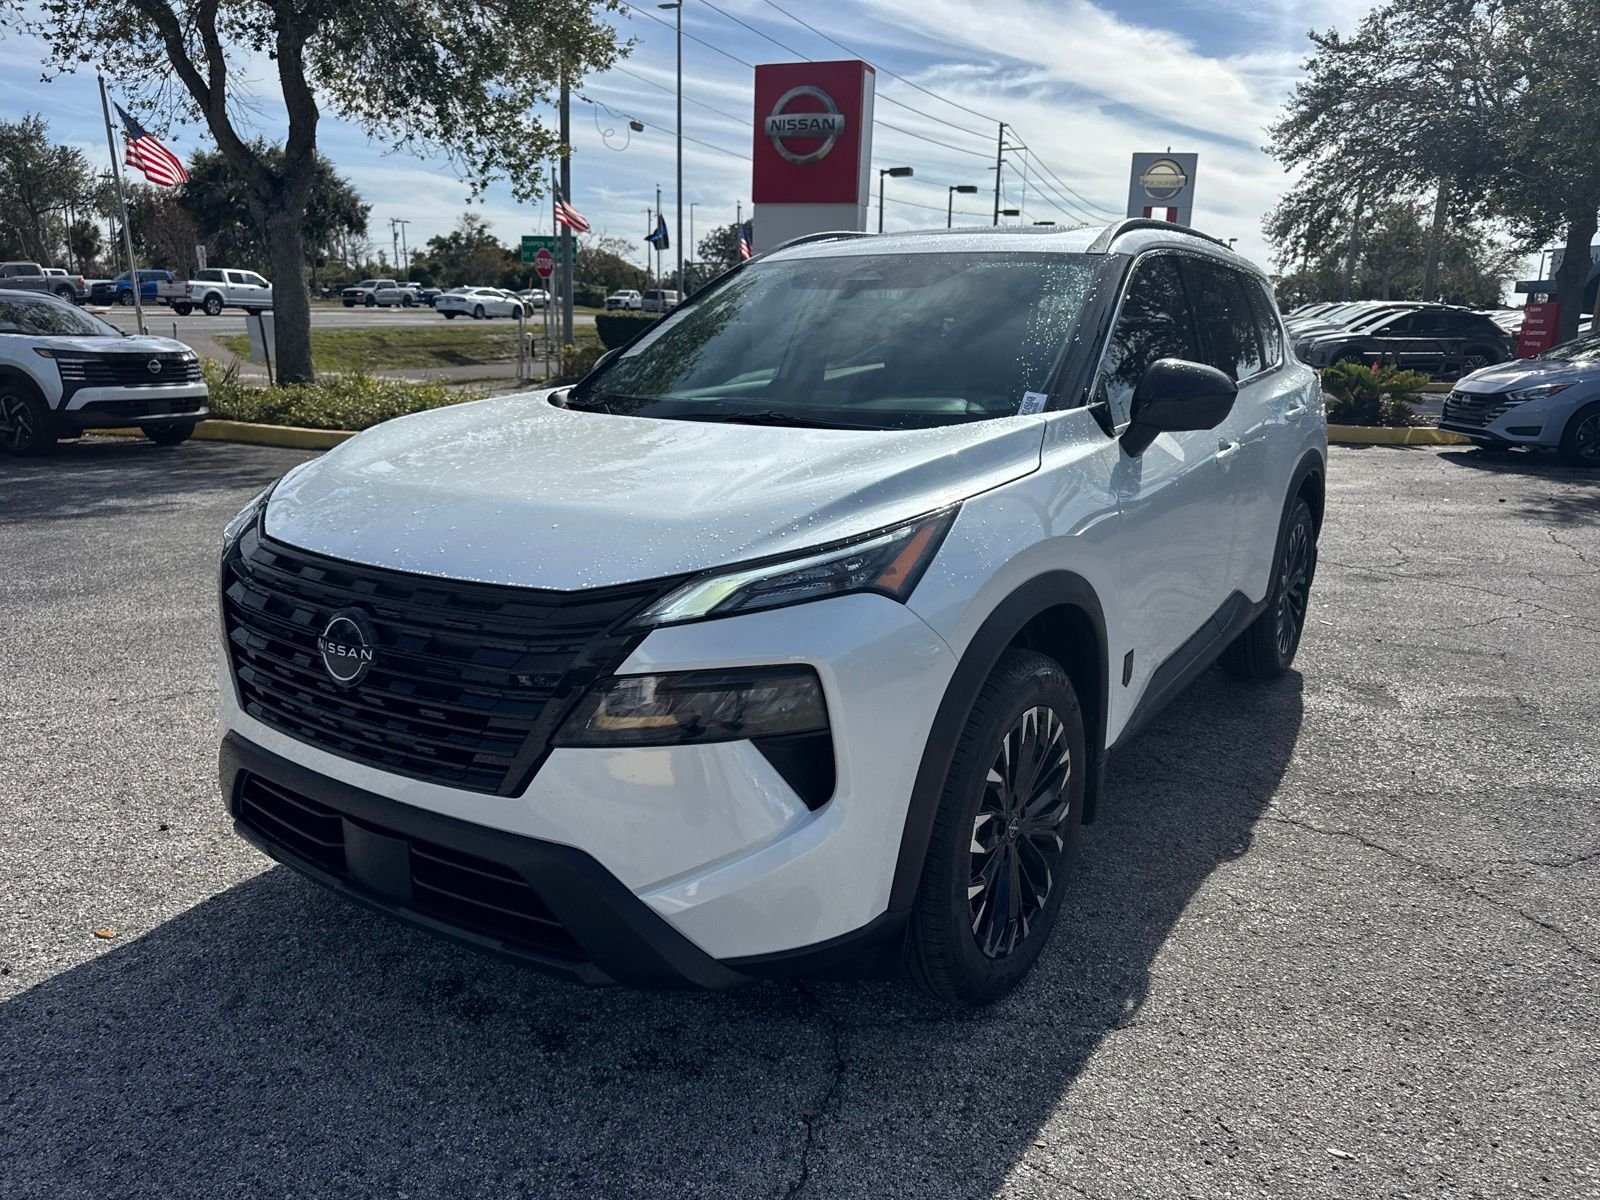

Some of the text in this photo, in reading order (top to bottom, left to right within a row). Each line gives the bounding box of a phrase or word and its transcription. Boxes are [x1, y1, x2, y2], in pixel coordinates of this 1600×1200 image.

[770, 118, 836, 132] NISSAN
[537, 257, 552, 268] STOP
[317, 637, 373, 661] NISSAN
